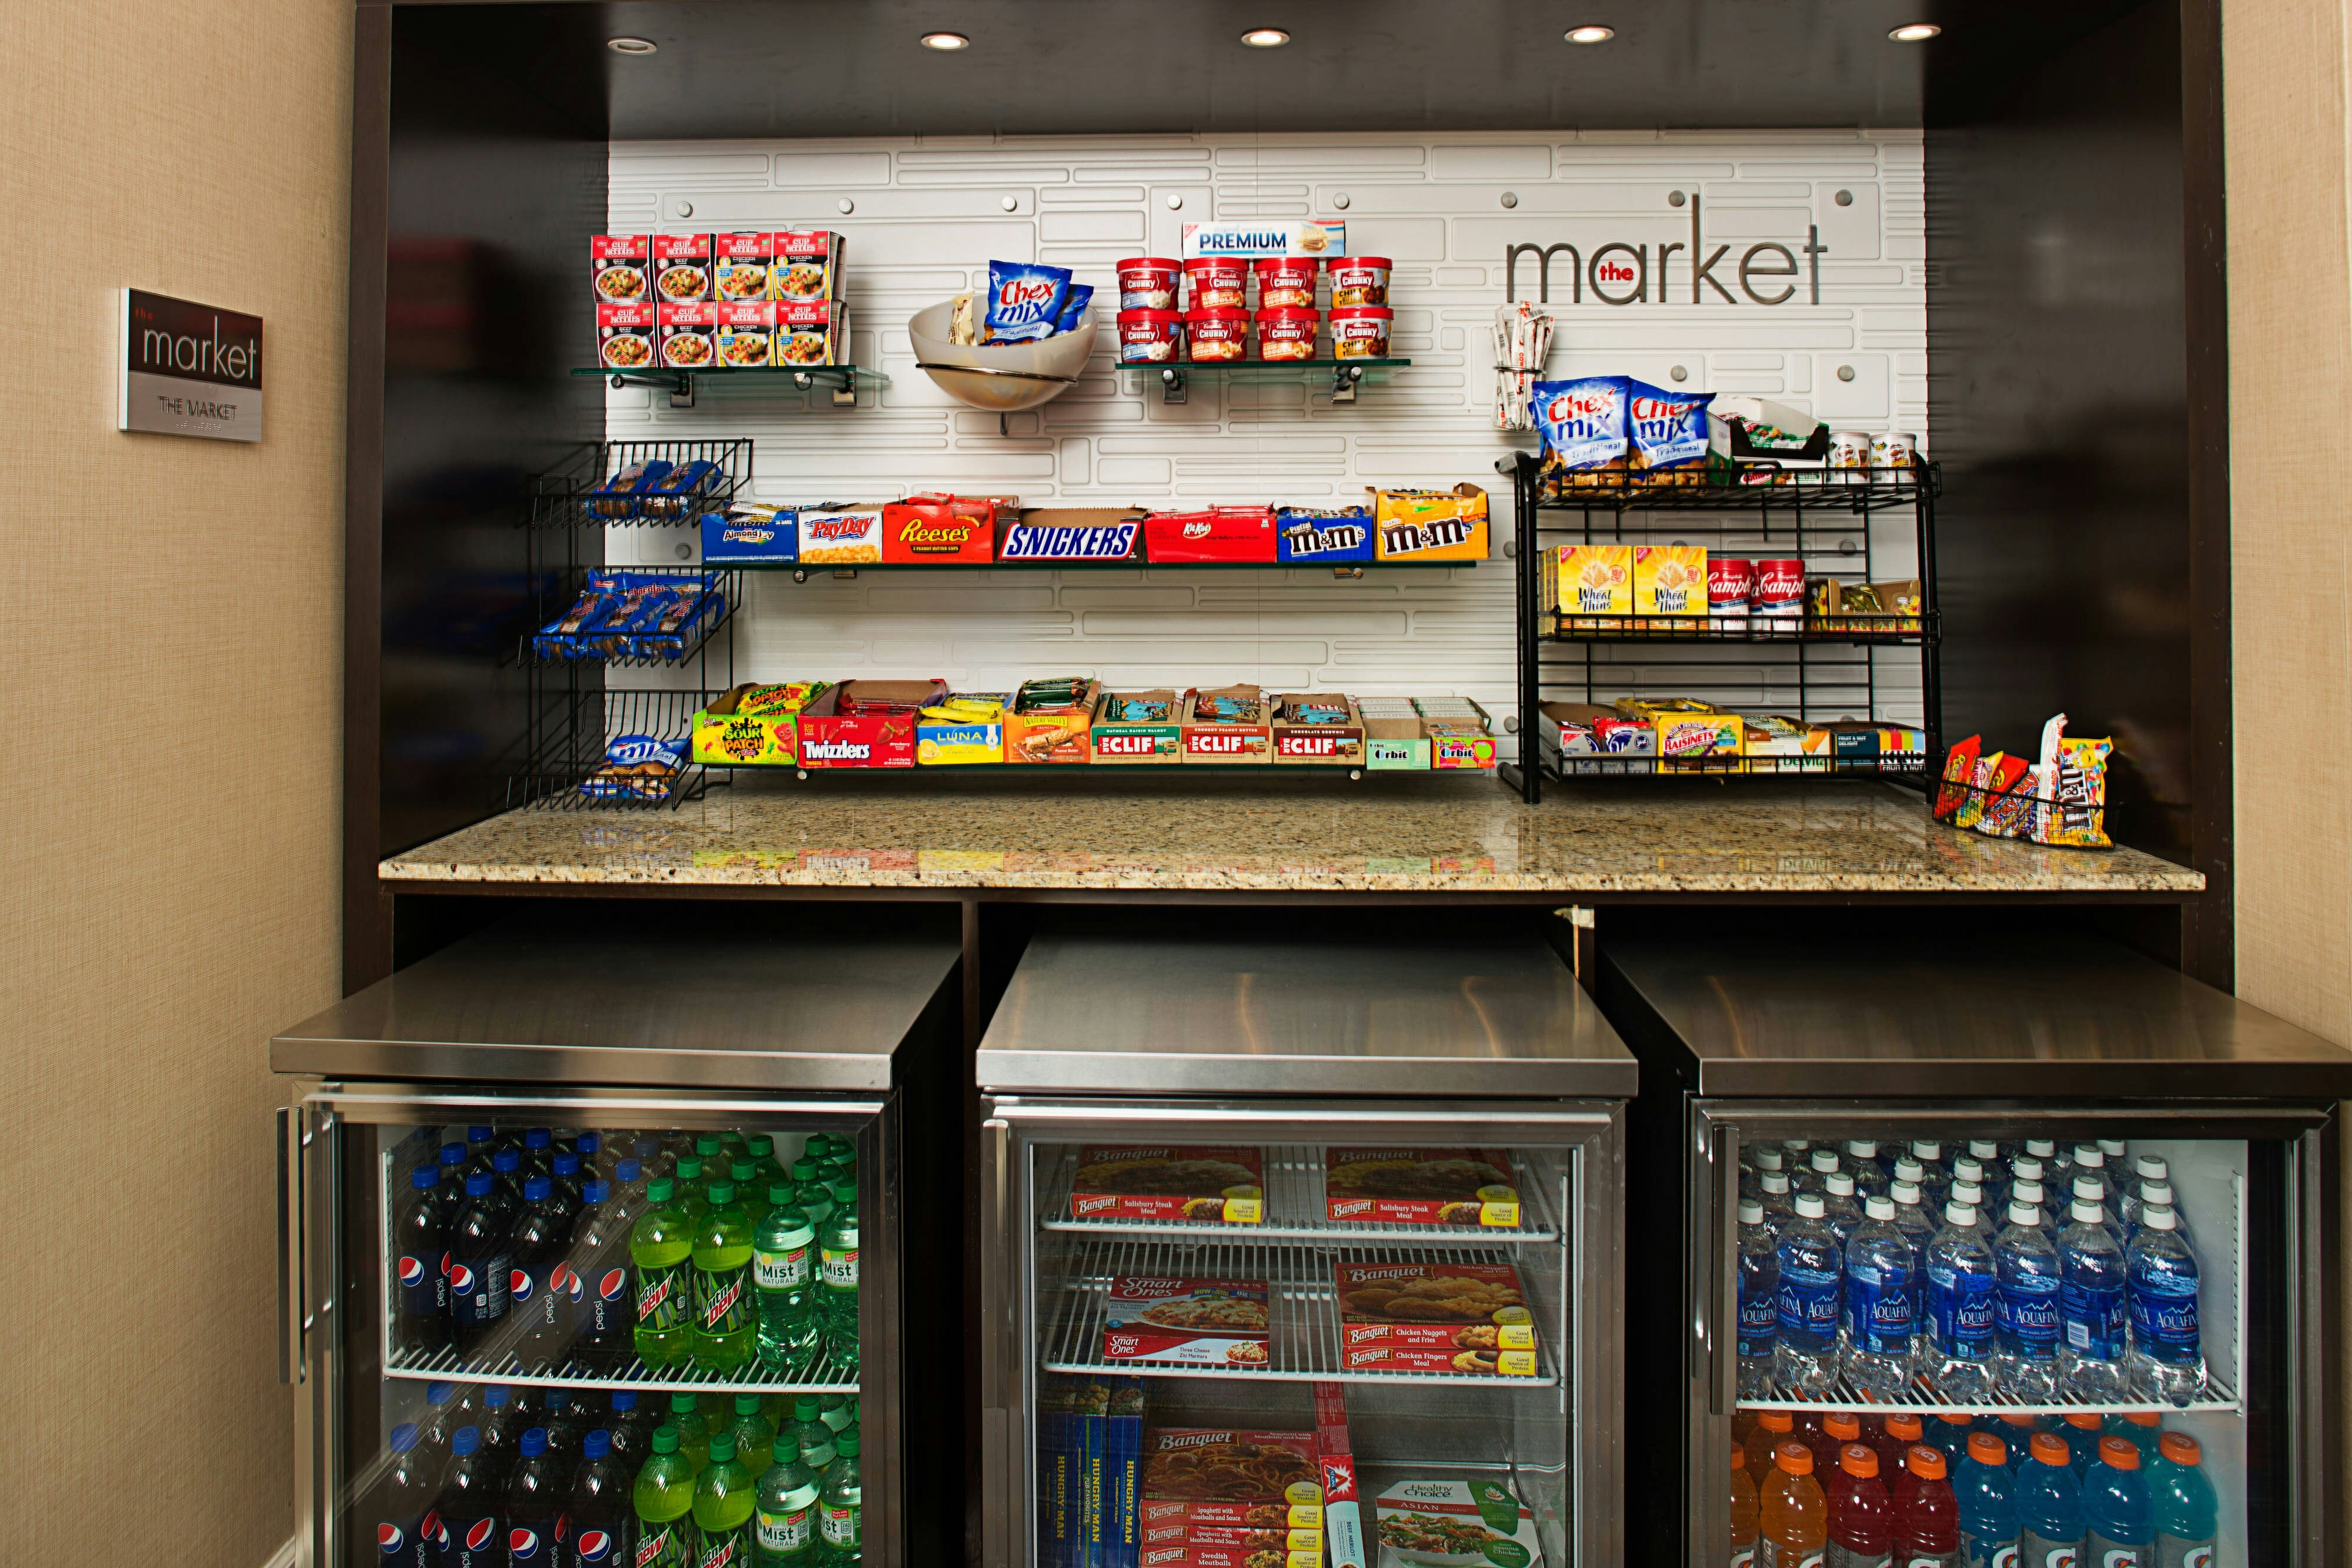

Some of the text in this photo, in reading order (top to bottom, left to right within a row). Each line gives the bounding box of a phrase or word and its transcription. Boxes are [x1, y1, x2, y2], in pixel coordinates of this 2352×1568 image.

[1200, 232, 1287, 249] PREMIUM
[1506, 193, 1828, 305] market
[1599, 261, 1634, 281] the
[1000, 279, 1061, 307] Chex
[996, 297, 1051, 323] mix
[143, 315, 256, 380] market
[158, 395, 237, 421] THE MARKET
[1548, 387, 1618, 423] Chex
[1558, 410, 1615, 441] mix
[1639, 411, 1689, 442] mix
[723, 529, 757, 541] Almond
[811, 515, 877, 541] PayDay
[898, 518, 972, 543] Reese's
[1289, 521, 1312, 534] Pretzel
[1005, 526, 1133, 556] SNICKERS
[1383, 517, 1473, 556] m&ms
[1578, 587, 1612, 601] Wheat
[1655, 587, 1688, 601] Wheat
[1576, 600, 1612, 613] Thins
[1653, 600, 1688, 613] Thins
[1025, 716, 1066, 726] NATURE VALLEY
[724, 728, 761, 739] SOUR
[937, 732, 983, 741] LUNA
[1665, 731, 1714, 751] RAISINETS
[724, 738, 764, 752] PATCH
[802, 740, 870, 759] Twizzlers
[1110, 737, 1152, 753] CLIF
[1199, 735, 1242, 751] CLIF
[1290, 738, 1334, 754] CLIF
[1375, 748, 1408, 760] Orbit
[1440, 747, 1474, 758] Orbit
[1079, 1197, 1116, 1213] Banquet
[1124, 1200, 1154, 1208] Salisbury
[1334, 1201, 1371, 1218] Banquet
[1379, 1204, 1410, 1213] Salisbury
[763, 1264, 794, 1278] Mist
[824, 1261, 851, 1276] Mist
[1350, 1266, 1425, 1282] Banquet
[825, 1274, 853, 1282] NATURAL
[1120, 1277, 1184, 1289] Smart
[435, 1278, 446, 1307] pepsi
[1122, 1286, 1175, 1298] Ones
[544, 1293, 555, 1324] pepsi
[594, 1299, 605, 1330] pepsi
[1956, 1308, 1994, 1325] AQUAFIN
[1110, 1335, 1139, 1346] Smart
[1351, 1326, 1388, 1343] Banquet
[1422, 1329, 1447, 1338] Nuggets
[1111, 1345, 1135, 1355] Ones
[1351, 1349, 1388, 1366] Banquet
[1424, 1353, 1447, 1361] Fingers
[1404, 1489, 1451, 1497] Choice
[1411, 1483, 1453, 1493] Healthy
[1057, 1455, 1065, 1539] HUNGRY-MAN
[1092, 1458, 1100, 1542] HUNGRY-MAN
[1124, 1460, 1134, 1544] HUNGRY-MAN
[1401, 1502, 1439, 1511] ASIAN
[763, 1526, 794, 1540] Mist
[763, 1539, 794, 1547] NATURAL
